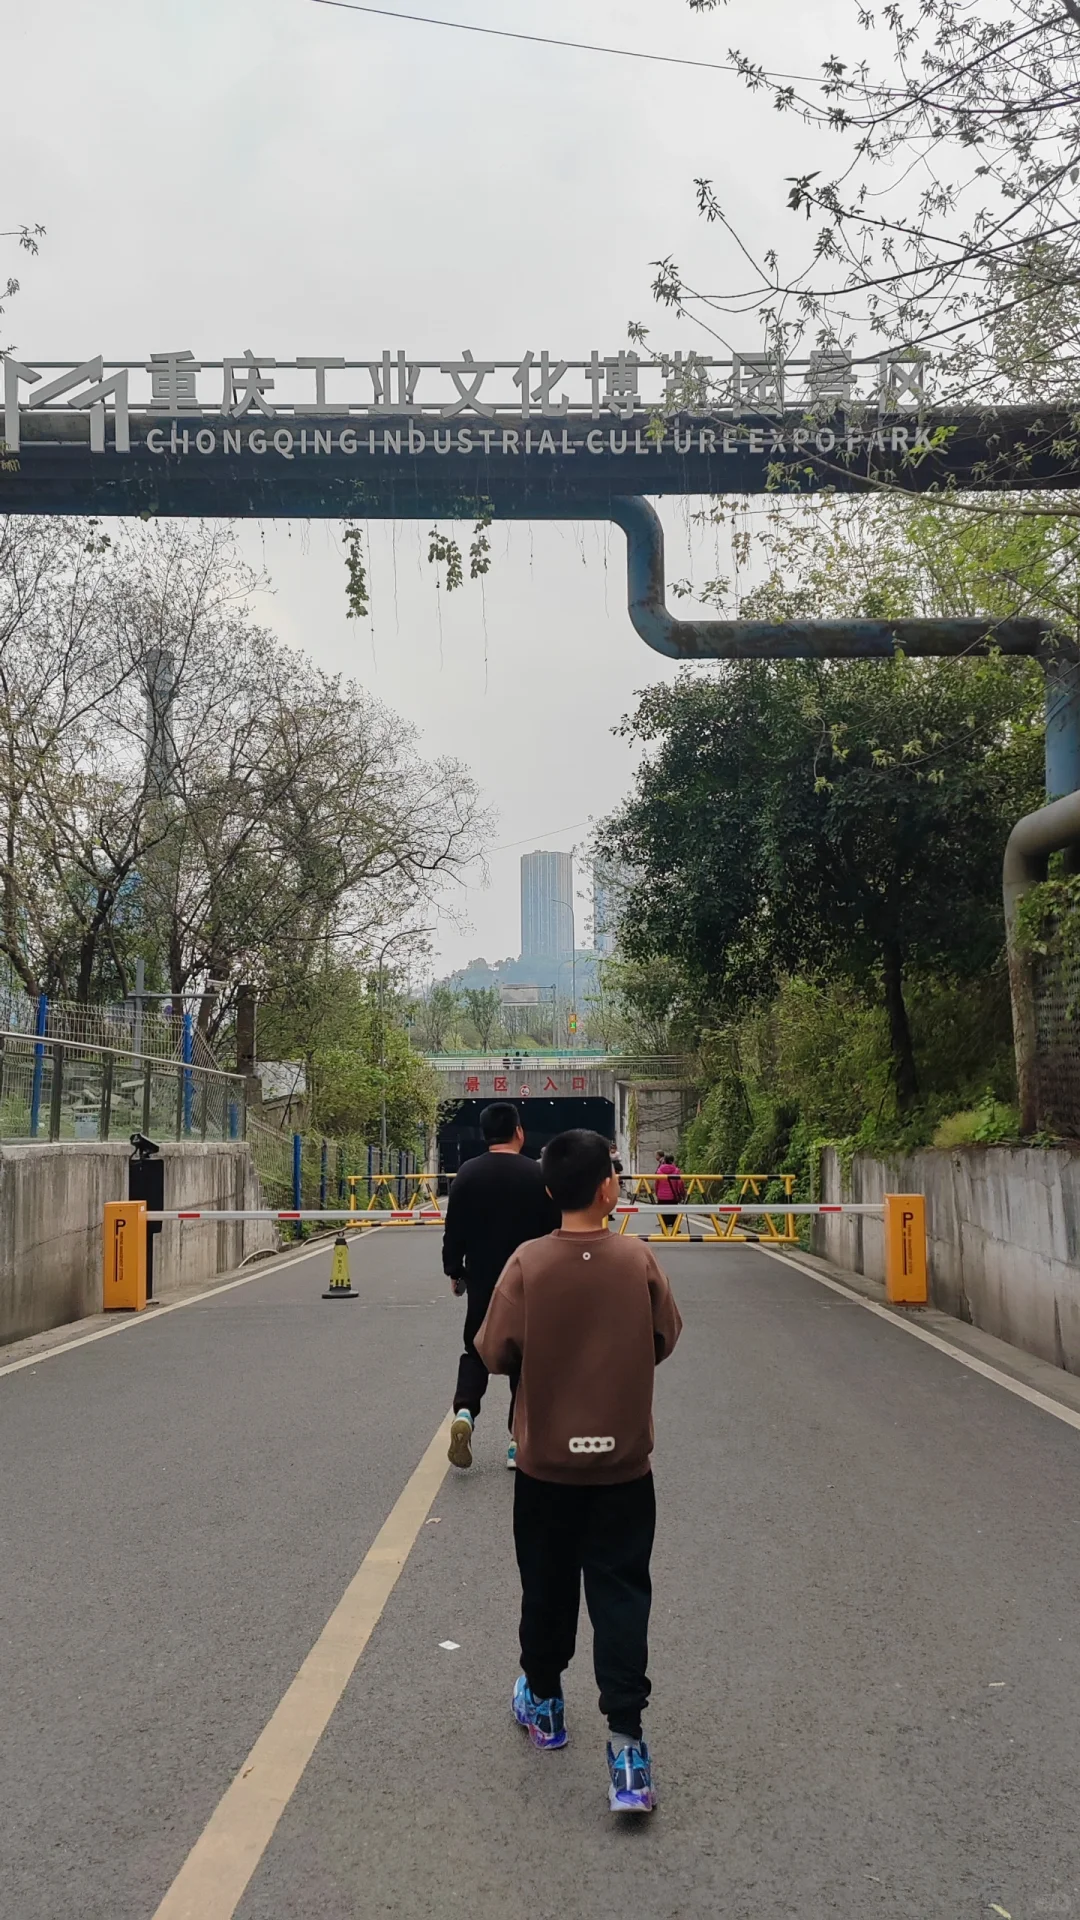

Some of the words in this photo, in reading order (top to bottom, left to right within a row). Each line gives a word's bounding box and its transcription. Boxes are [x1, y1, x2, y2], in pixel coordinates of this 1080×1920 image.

[145, 349, 931, 418] 重庆工业文化博览园景区
[146, 427, 358, 459] CHONGQING
[369, 428, 577, 455] INDUSTRIAL
[586, 428, 738, 455] CULTURE
[749, 427, 836, 454] EXPO
[846, 425, 934, 452] PARK
[466, 1076, 586, 1092] 景区入口
